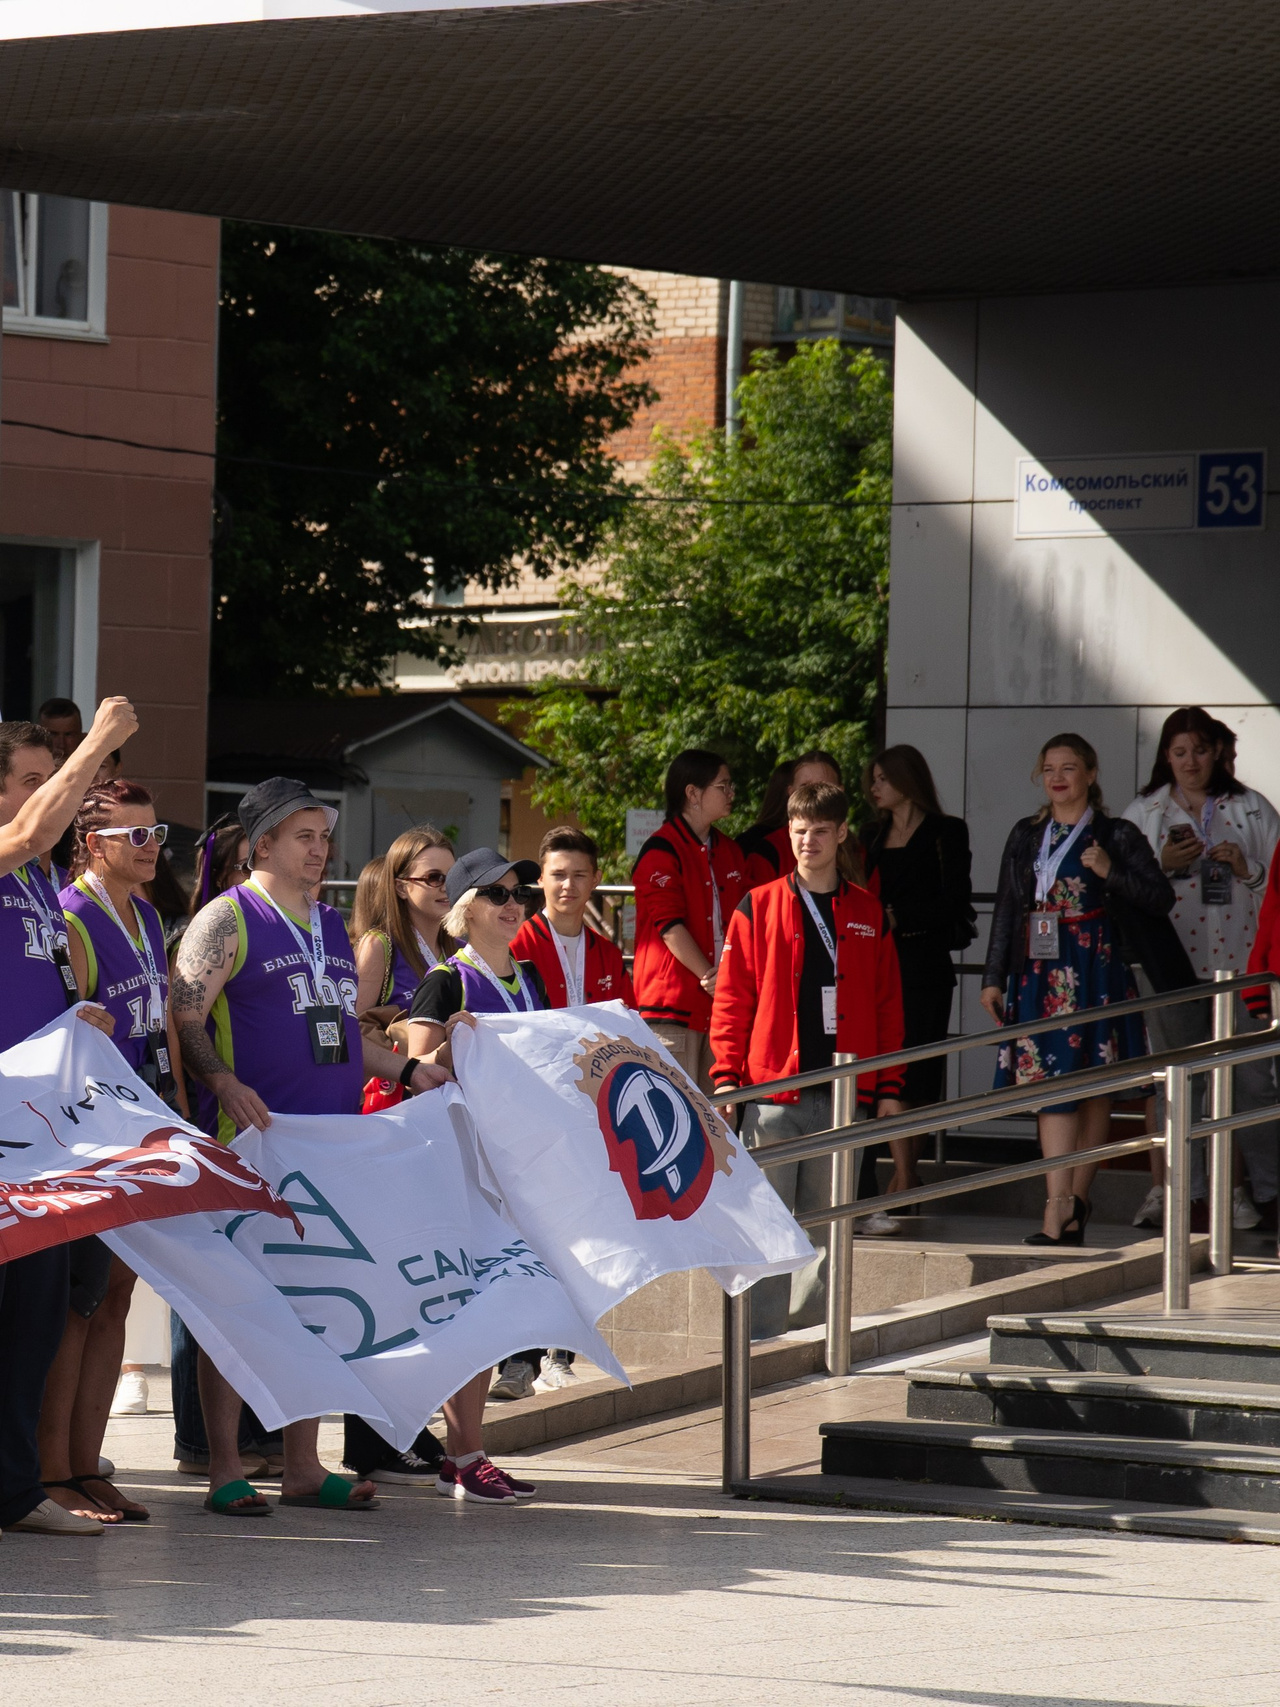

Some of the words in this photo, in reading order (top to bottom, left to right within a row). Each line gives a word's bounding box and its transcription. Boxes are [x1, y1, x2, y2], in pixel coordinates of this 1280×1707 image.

[1025, 468, 1189, 493] Комсомольский
[1205, 464, 1258, 516] 53
[1069, 496, 1143, 514] проспект
[287, 972, 359, 1019] 102
[590, 1043, 654, 1079] ТРУДОВЫЕ
[60, 1081, 140, 1125] УМПО
